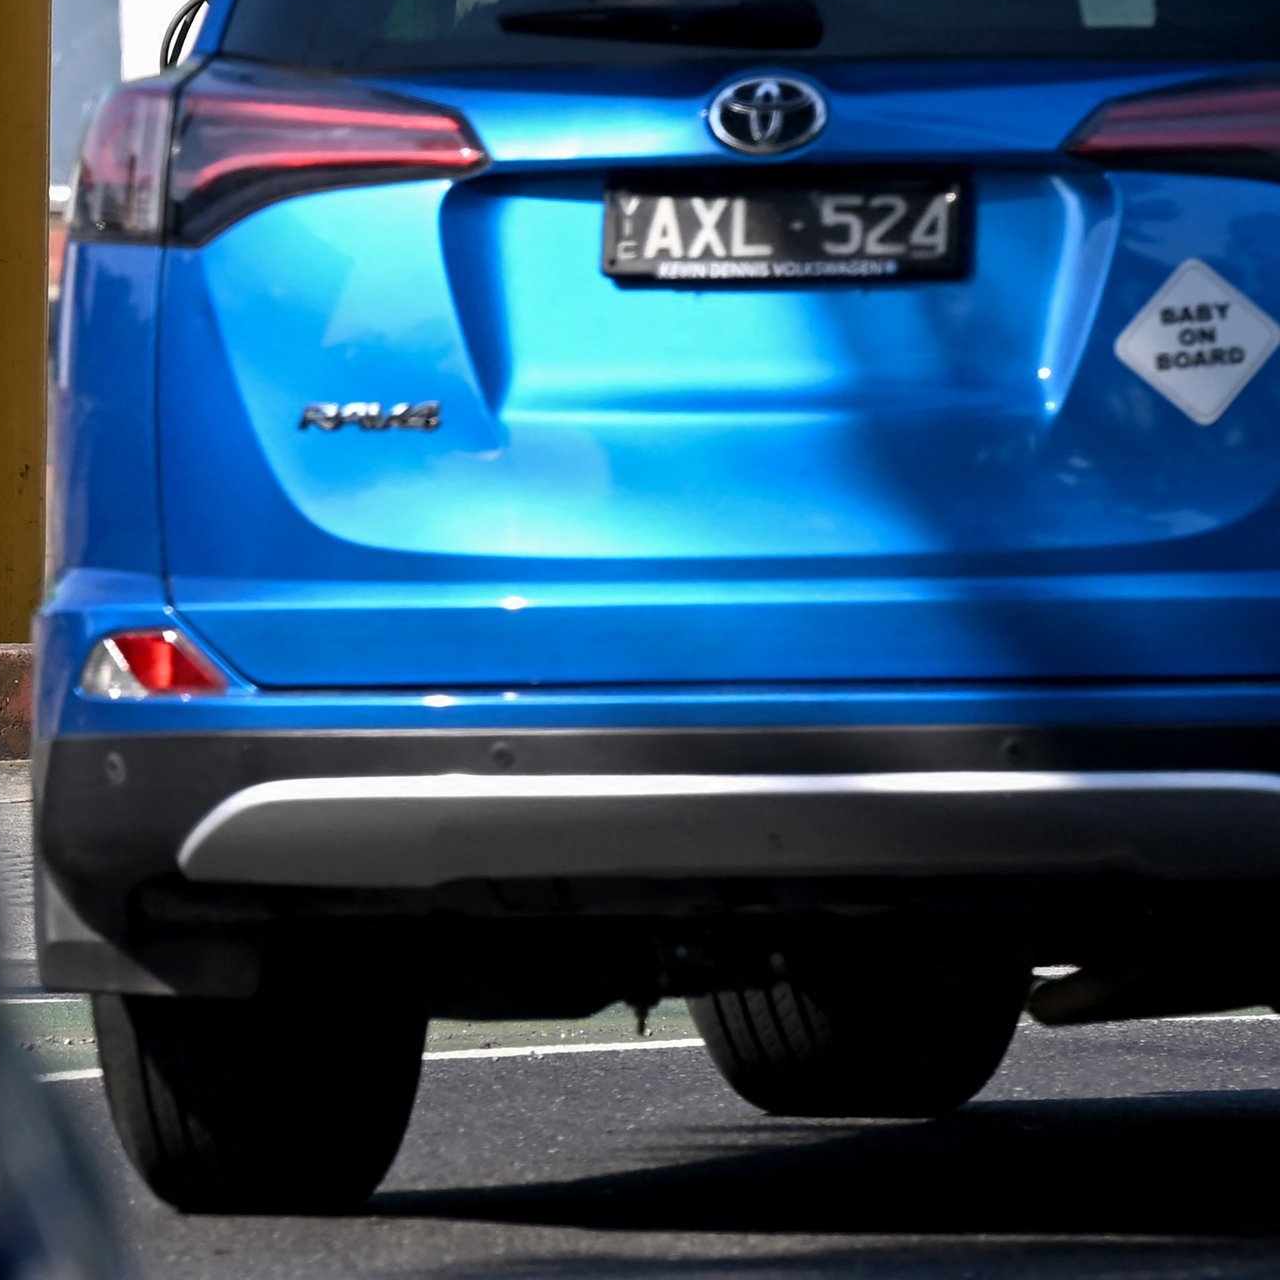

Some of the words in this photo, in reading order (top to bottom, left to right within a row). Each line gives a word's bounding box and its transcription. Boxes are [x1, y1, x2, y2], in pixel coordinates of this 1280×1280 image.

[643, 196, 775, 259] AXL
[820, 193, 952, 260] 524
[657, 262, 707, 279] KEVIN
[709, 262, 771, 279] DENNIS
[772, 260, 882, 278] VOLKSWAGEN
[1159, 302, 1231, 326] BABY
[1177, 327, 1217, 347] ON
[1155, 346, 1246, 370] BOARD
[298, 400, 441, 433] RAV4
